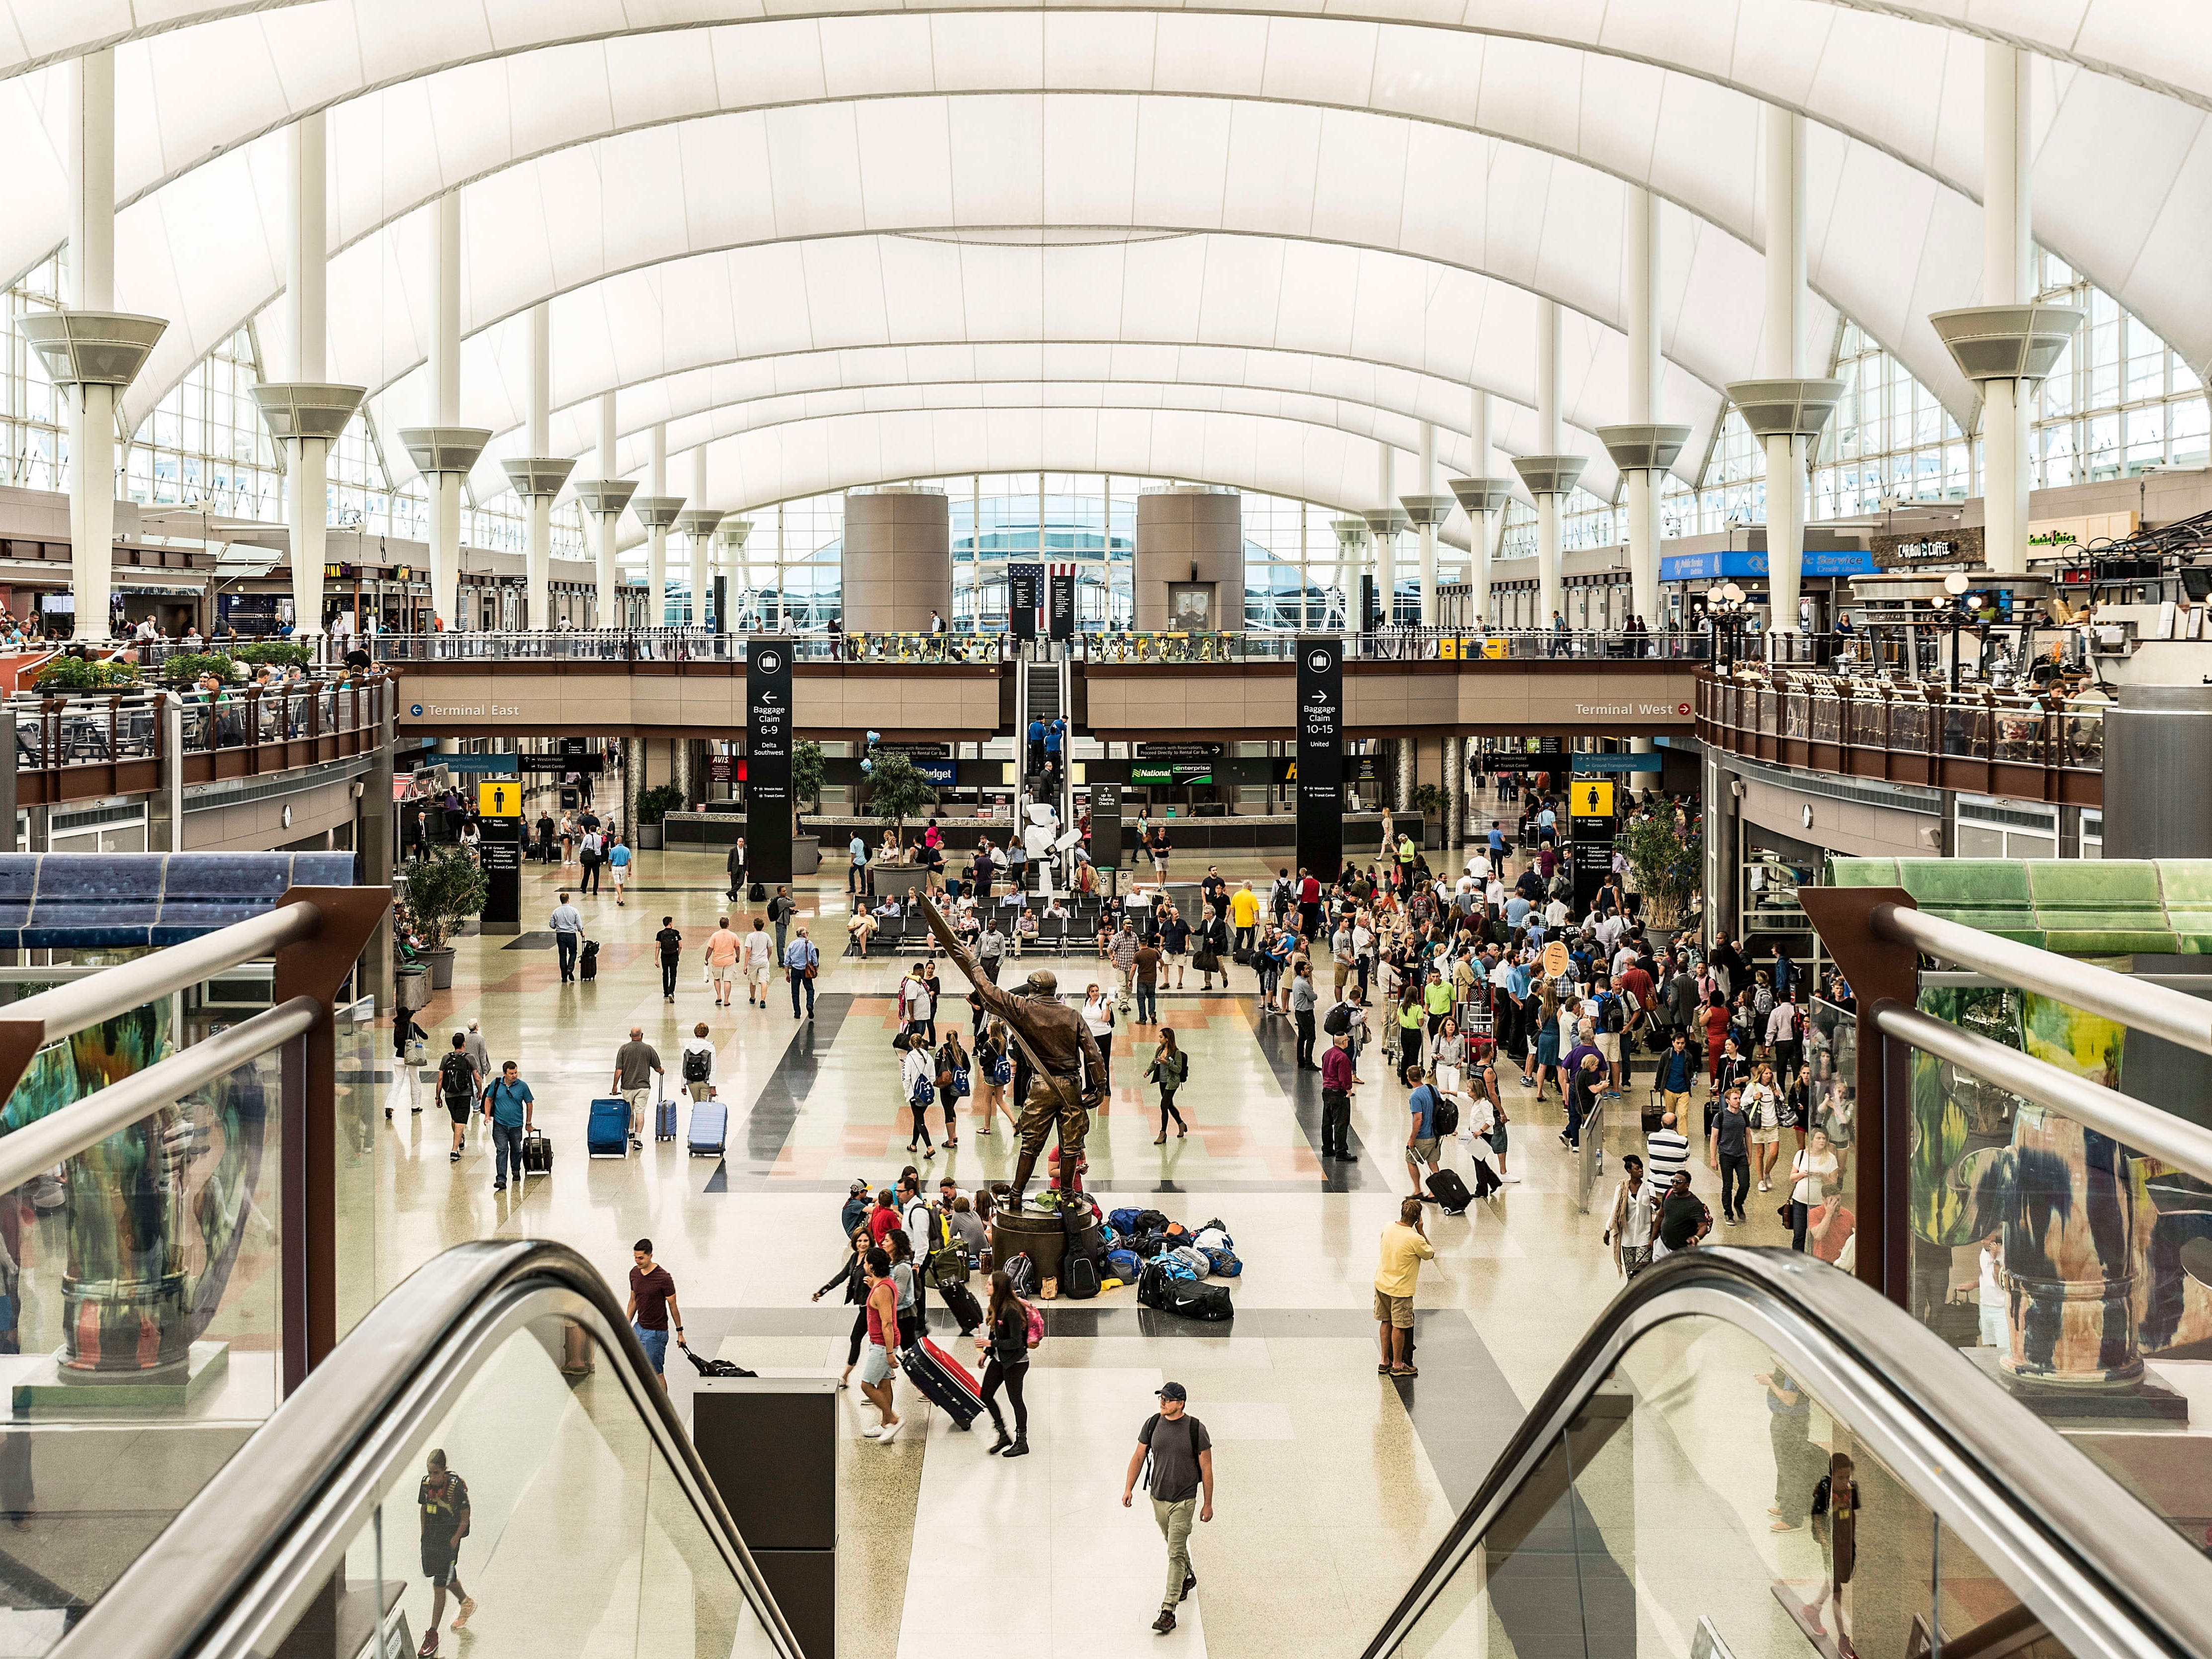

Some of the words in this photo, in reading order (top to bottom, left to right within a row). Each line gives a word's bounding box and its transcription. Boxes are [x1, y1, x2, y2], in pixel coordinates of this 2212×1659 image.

[1898, 542, 1921, 558] CARIBOU
[1928, 541, 1950, 556] COFFEE
[1817, 555, 1863, 565] Service
[428, 704, 485, 716] Terminal
[492, 705, 519, 716] East
[1304, 705, 1335, 714] Baggage
[1576, 703, 1632, 715] Terminal
[1639, 704, 1673, 715] West
[761, 725, 778, 734] 6-9
[1306, 725, 1333, 733] 10-15
[923, 768, 951, 781] udget
